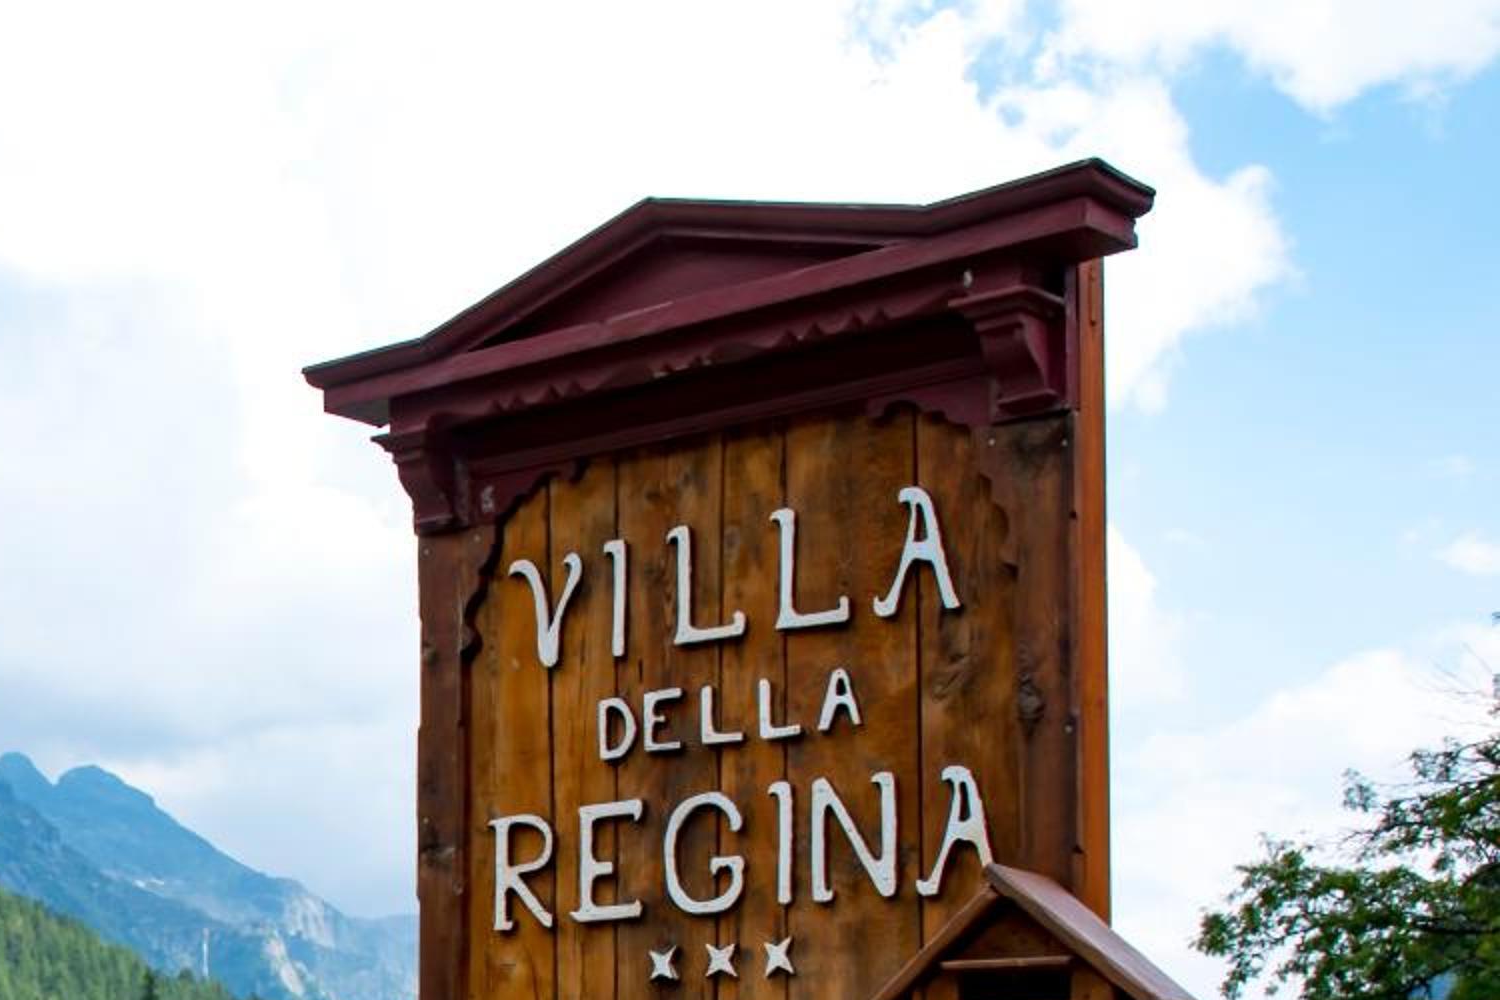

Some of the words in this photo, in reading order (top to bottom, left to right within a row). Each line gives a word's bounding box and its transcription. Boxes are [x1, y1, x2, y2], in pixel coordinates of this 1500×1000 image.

[509, 487, 961, 667] VILLA
[598, 667, 862, 760] DELLA
[488, 765, 993, 931] REGINA
